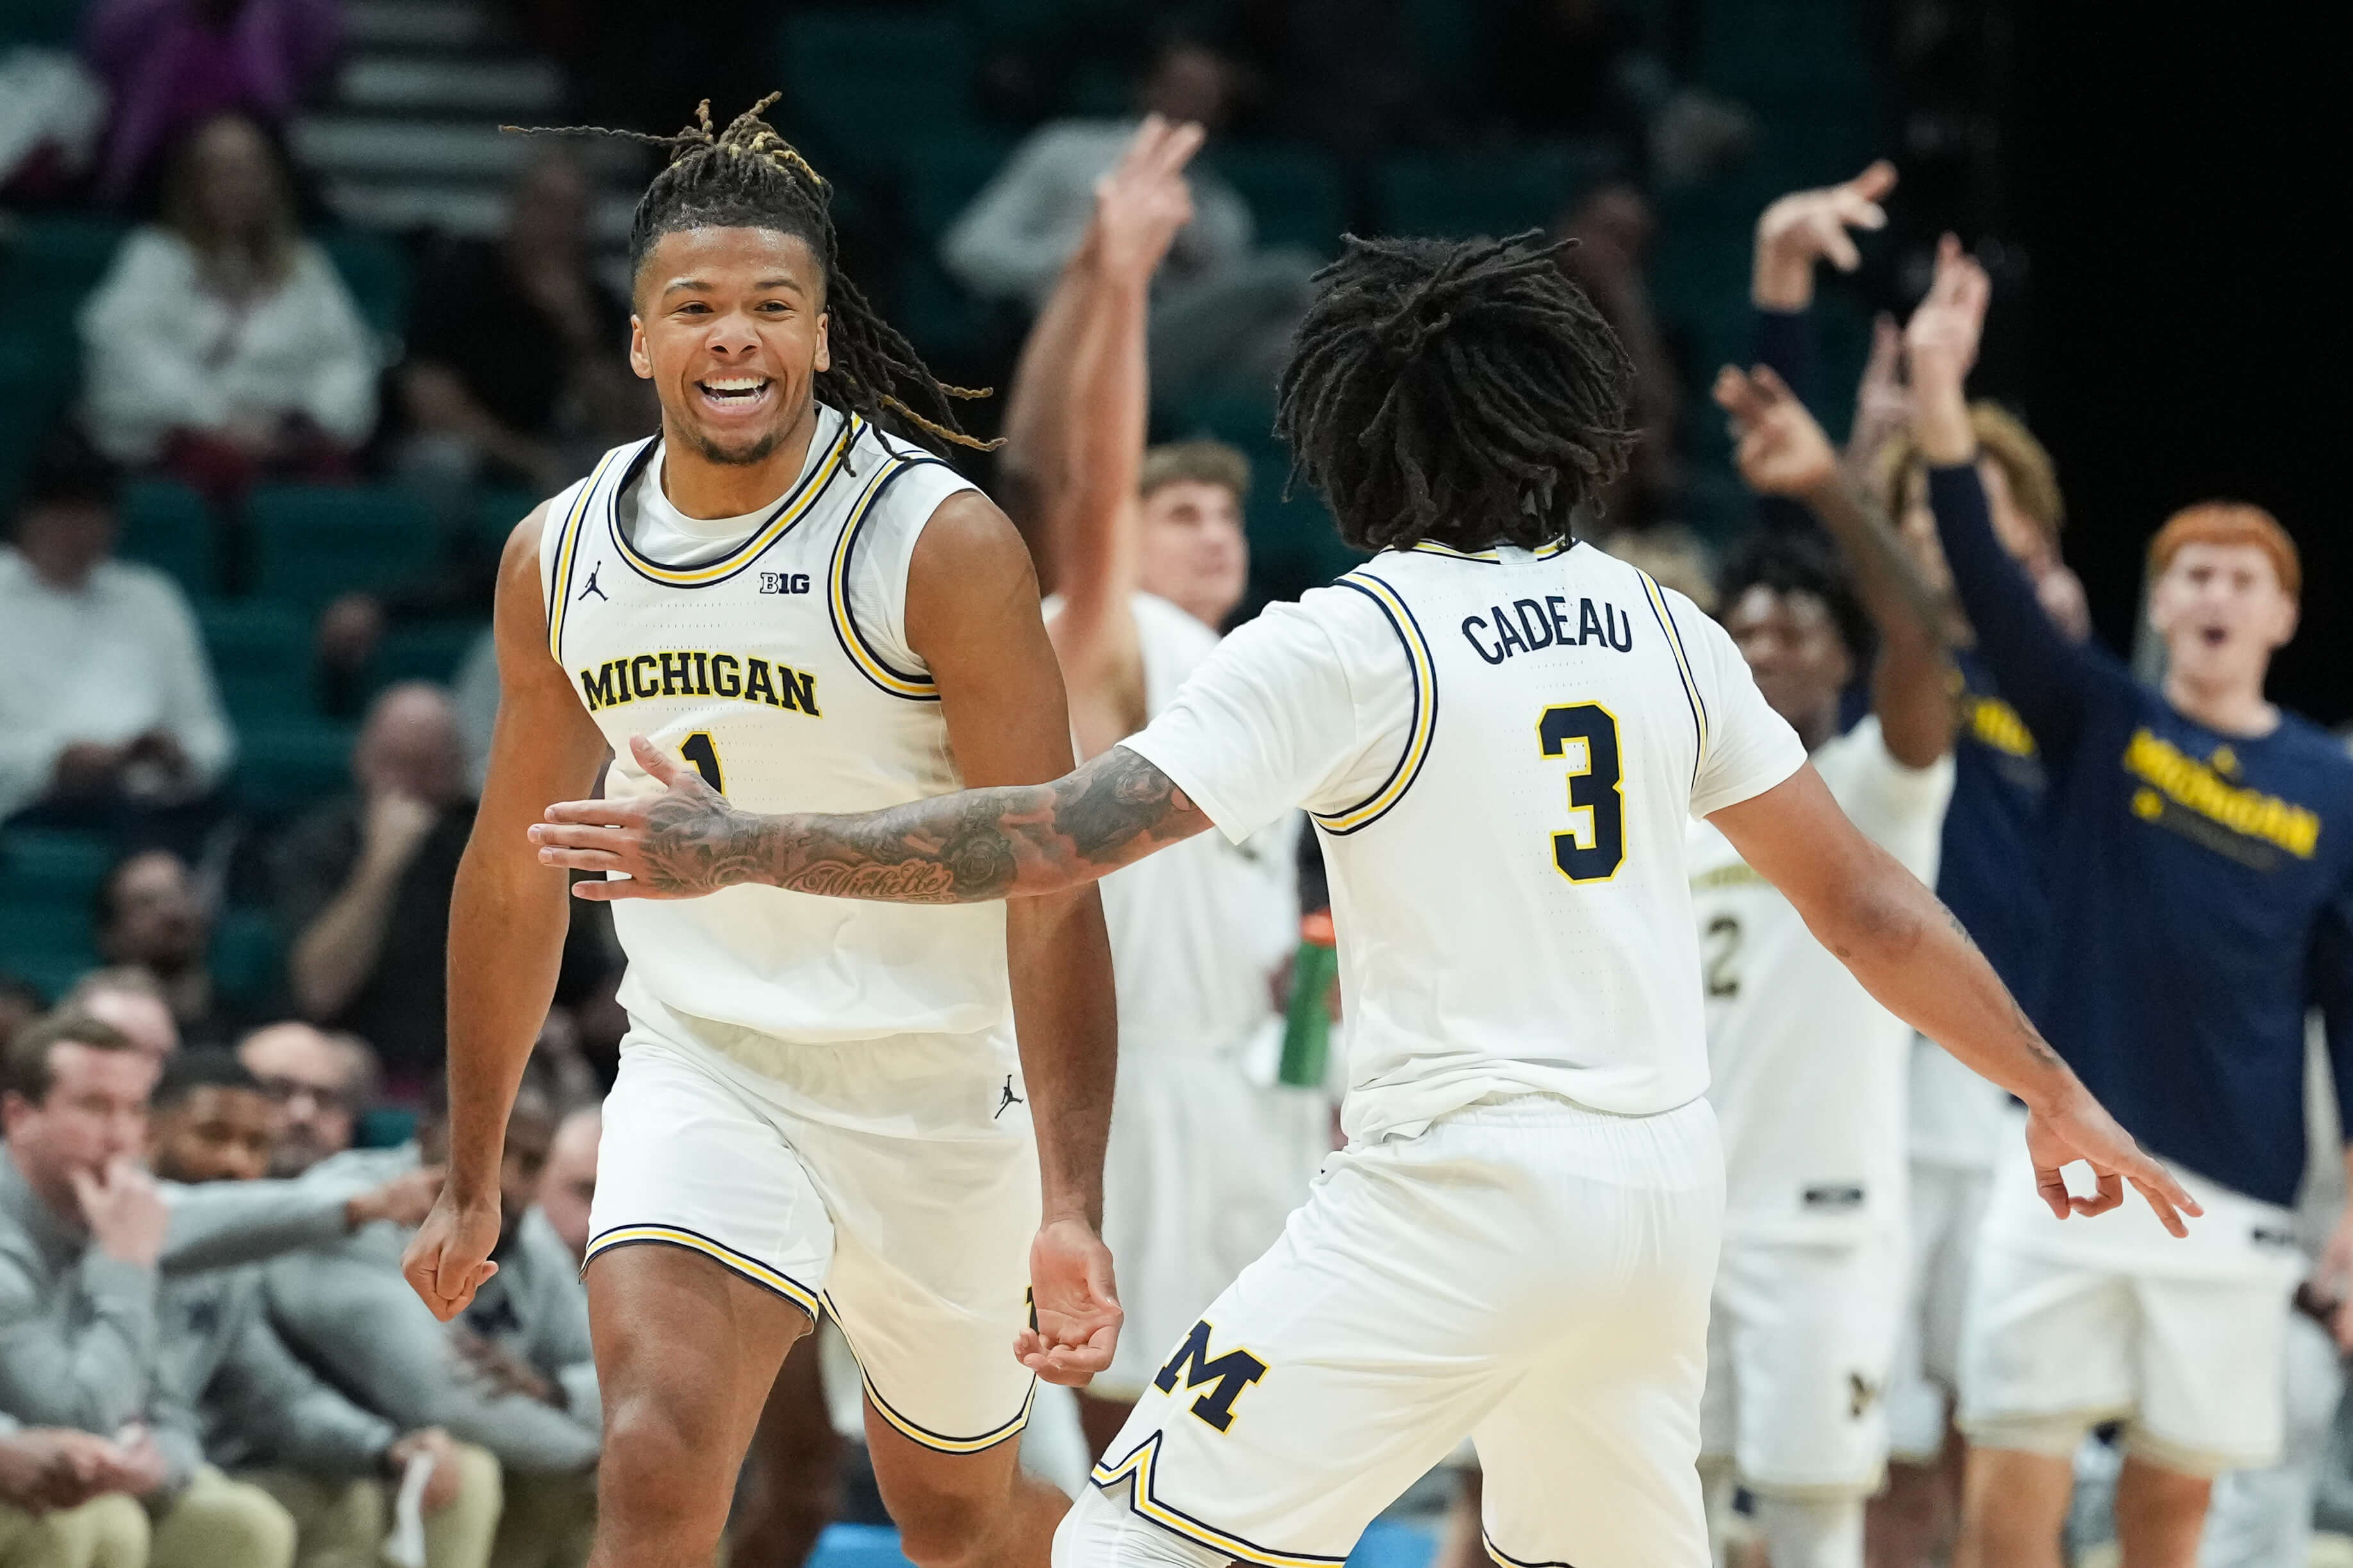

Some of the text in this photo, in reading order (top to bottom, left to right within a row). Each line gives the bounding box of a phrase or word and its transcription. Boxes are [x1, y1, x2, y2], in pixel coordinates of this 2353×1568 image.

[1462, 596, 1632, 665] CADEAU
[581, 650, 822, 718] MICHIGAN
[1535, 700, 1626, 884] 3
[1707, 913, 1740, 999] 2
[1154, 1319, 1270, 1435] M
